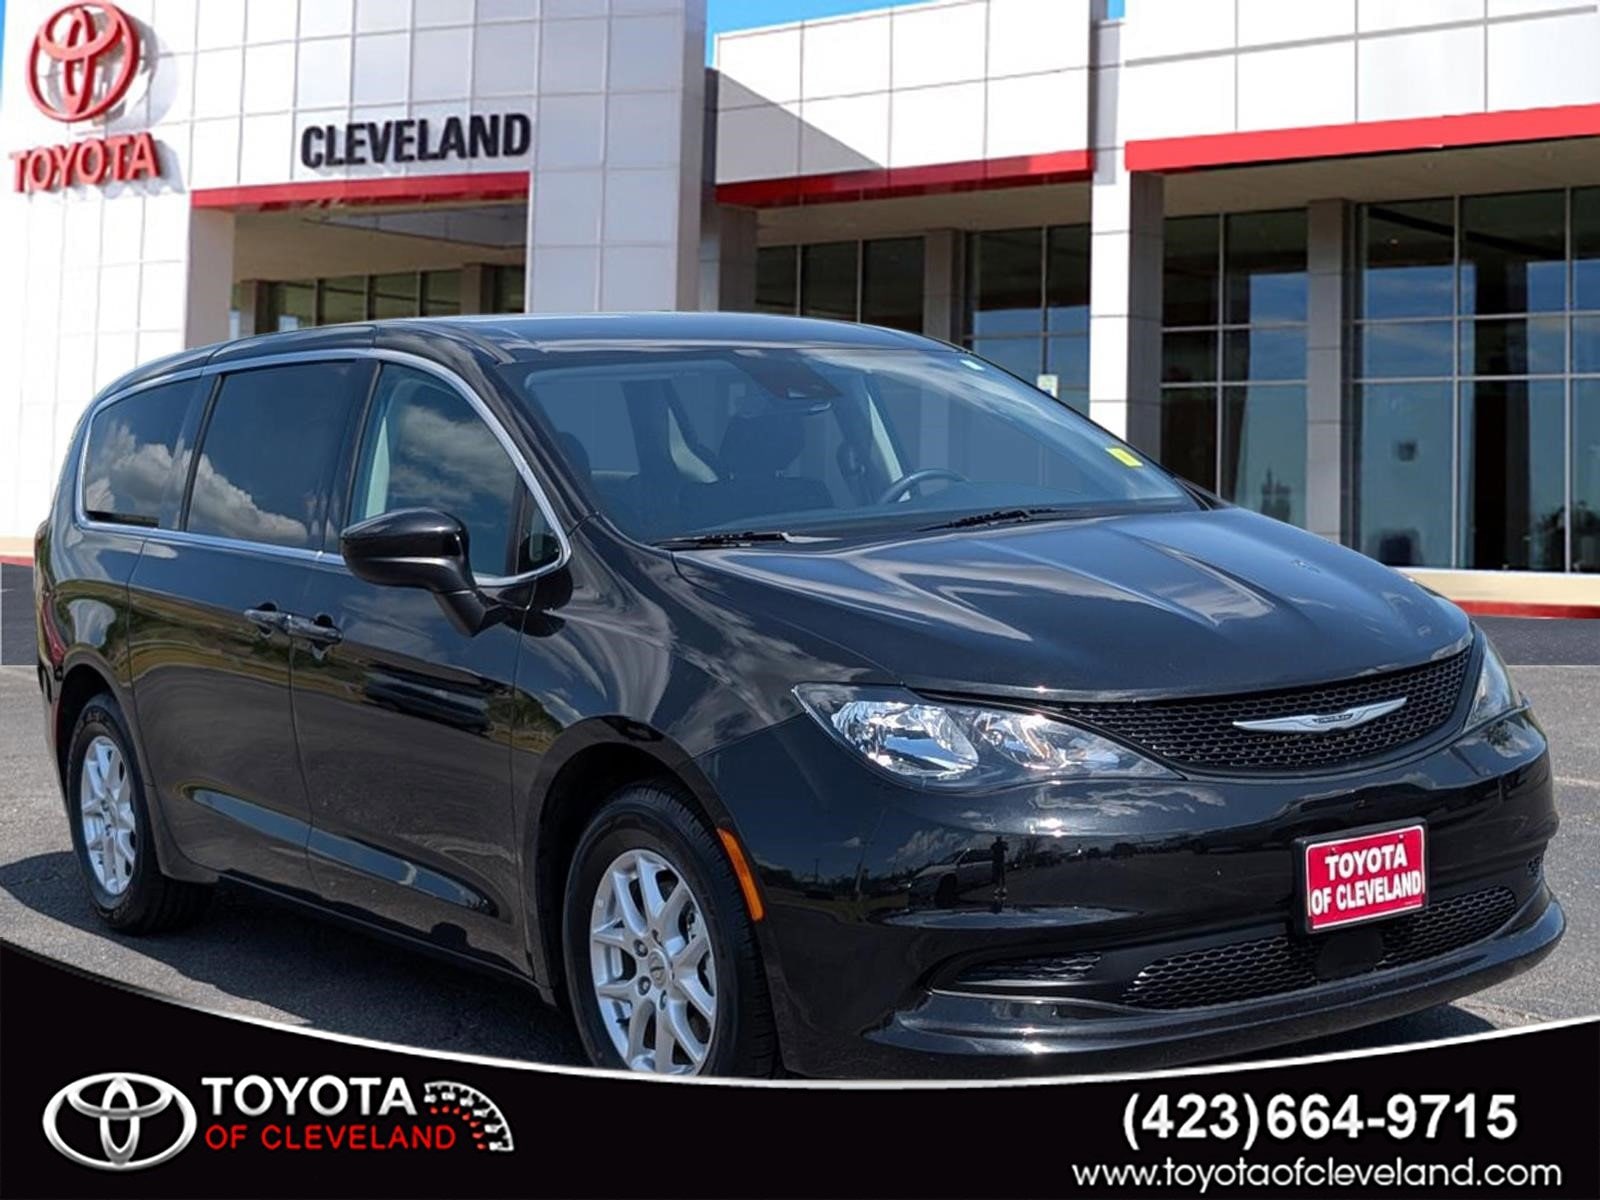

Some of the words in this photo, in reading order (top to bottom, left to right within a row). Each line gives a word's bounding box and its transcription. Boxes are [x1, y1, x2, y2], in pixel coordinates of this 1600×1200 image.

[9, 132, 162, 193] TOYOTA
[301, 113, 531, 169] CLEVELAND
[1325, 843, 1408, 881] TOYOTA
[1311, 887, 1332, 915] OF
[1336, 870, 1421, 911] CLEVELAND
